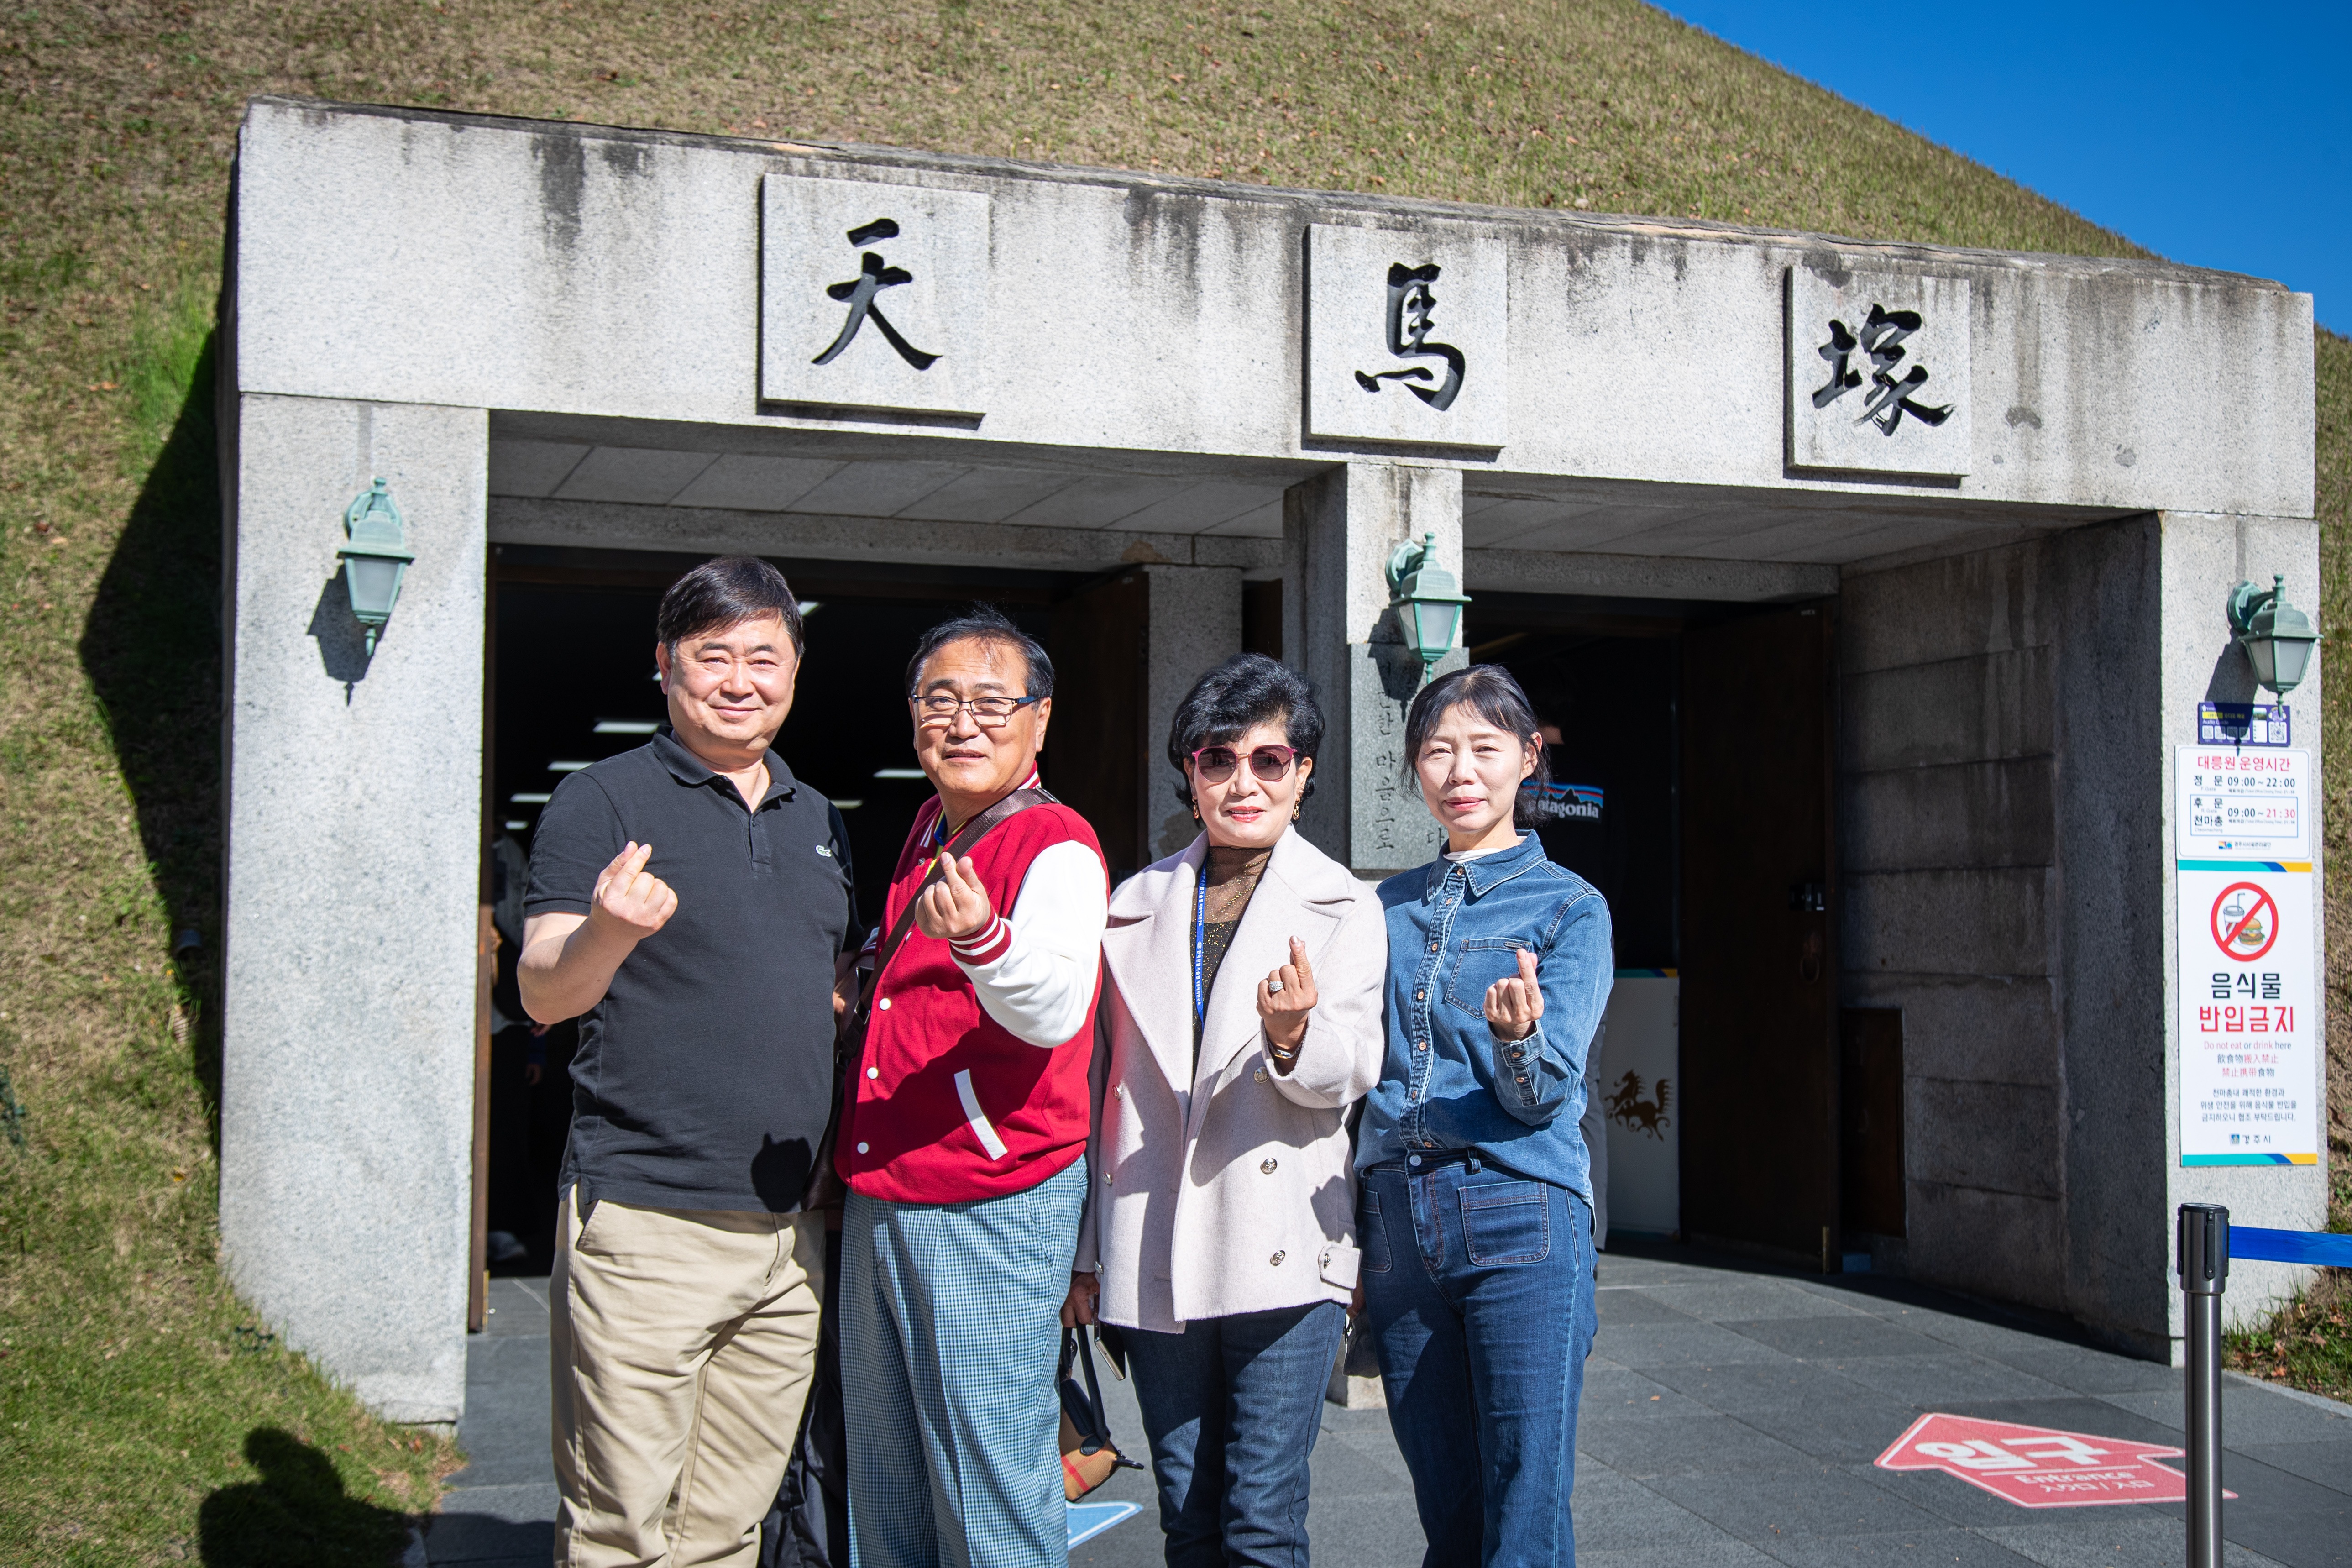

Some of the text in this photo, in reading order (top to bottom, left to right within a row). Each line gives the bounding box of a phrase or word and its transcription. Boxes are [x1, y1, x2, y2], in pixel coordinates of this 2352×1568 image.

[2198, 756, 2290, 771] 대릉원 운영시간
[1374, 751, 1396, 850] 마음으로
[1536, 799, 1598, 818] atagonia
[2195, 816, 2223, 826] 천마총
[2211, 973, 2281, 999] 음식물
[2200, 1006, 2293, 1032] 반입금지
[2204, 1041, 2215, 1050] Do
[2216, 1041, 2228, 1049] not
[2231, 1041, 2242, 1049] eat
[2253, 1041, 2273, 1049] drink
[2275, 1041, 2292, 1049] here
[2213, 1088, 2284, 1097] 천마총내 쾌적한 환경과
[2200, 1101, 2296, 1110] 위생 안전을 위해 음식물 반입을
[2202, 1113, 2295, 1122] 금지하오니 협조 부탁드립니다.
[2243, 1135, 2271, 1144] 경주시
[1915, 1436, 2111, 1469] 입구
[2014, 1472, 2135, 1484] Entrance
